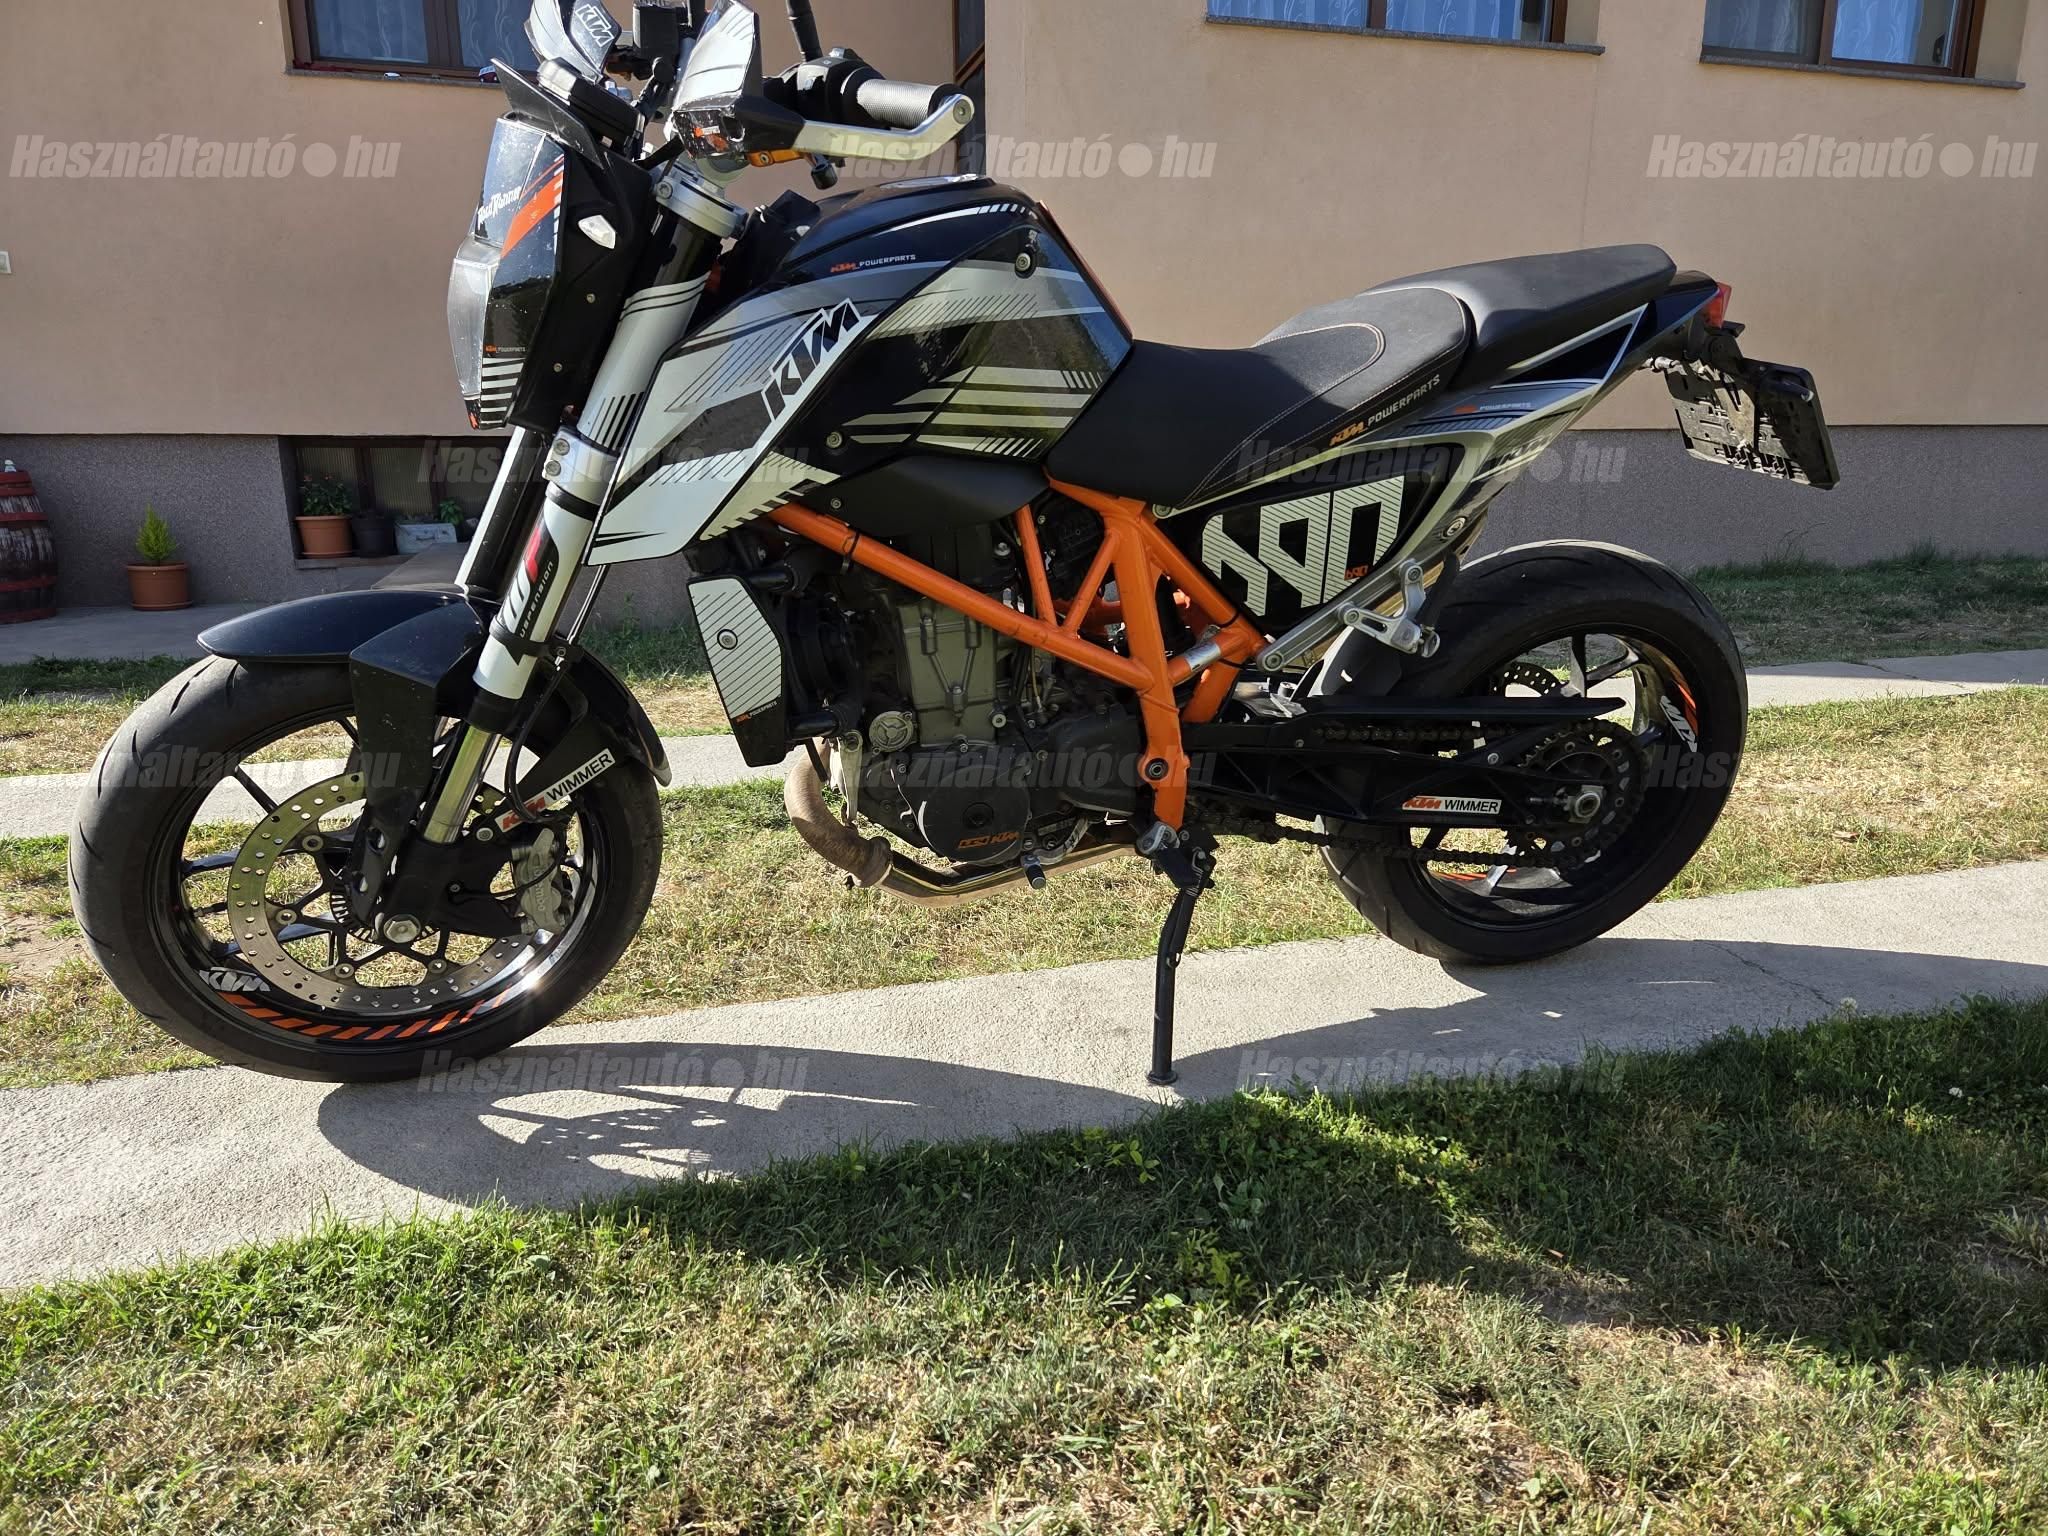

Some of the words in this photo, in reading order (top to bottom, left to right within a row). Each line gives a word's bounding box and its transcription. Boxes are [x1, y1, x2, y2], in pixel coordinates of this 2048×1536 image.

[575, 4, 614, 47] KTM
[859, 254, 916, 267] POWERPARTS
[763, 300, 860, 421] KTM
[1329, 421, 1365, 447] KTM
[1367, 374, 1440, 427] POWERPARTS
[519, 561, 554, 639] USPENSION
[547, 754, 613, 801] WIMMER
[1404, 797, 1441, 809] KTM
[1443, 800, 1499, 813] WIMMER
[199, 966, 271, 992] KTM
